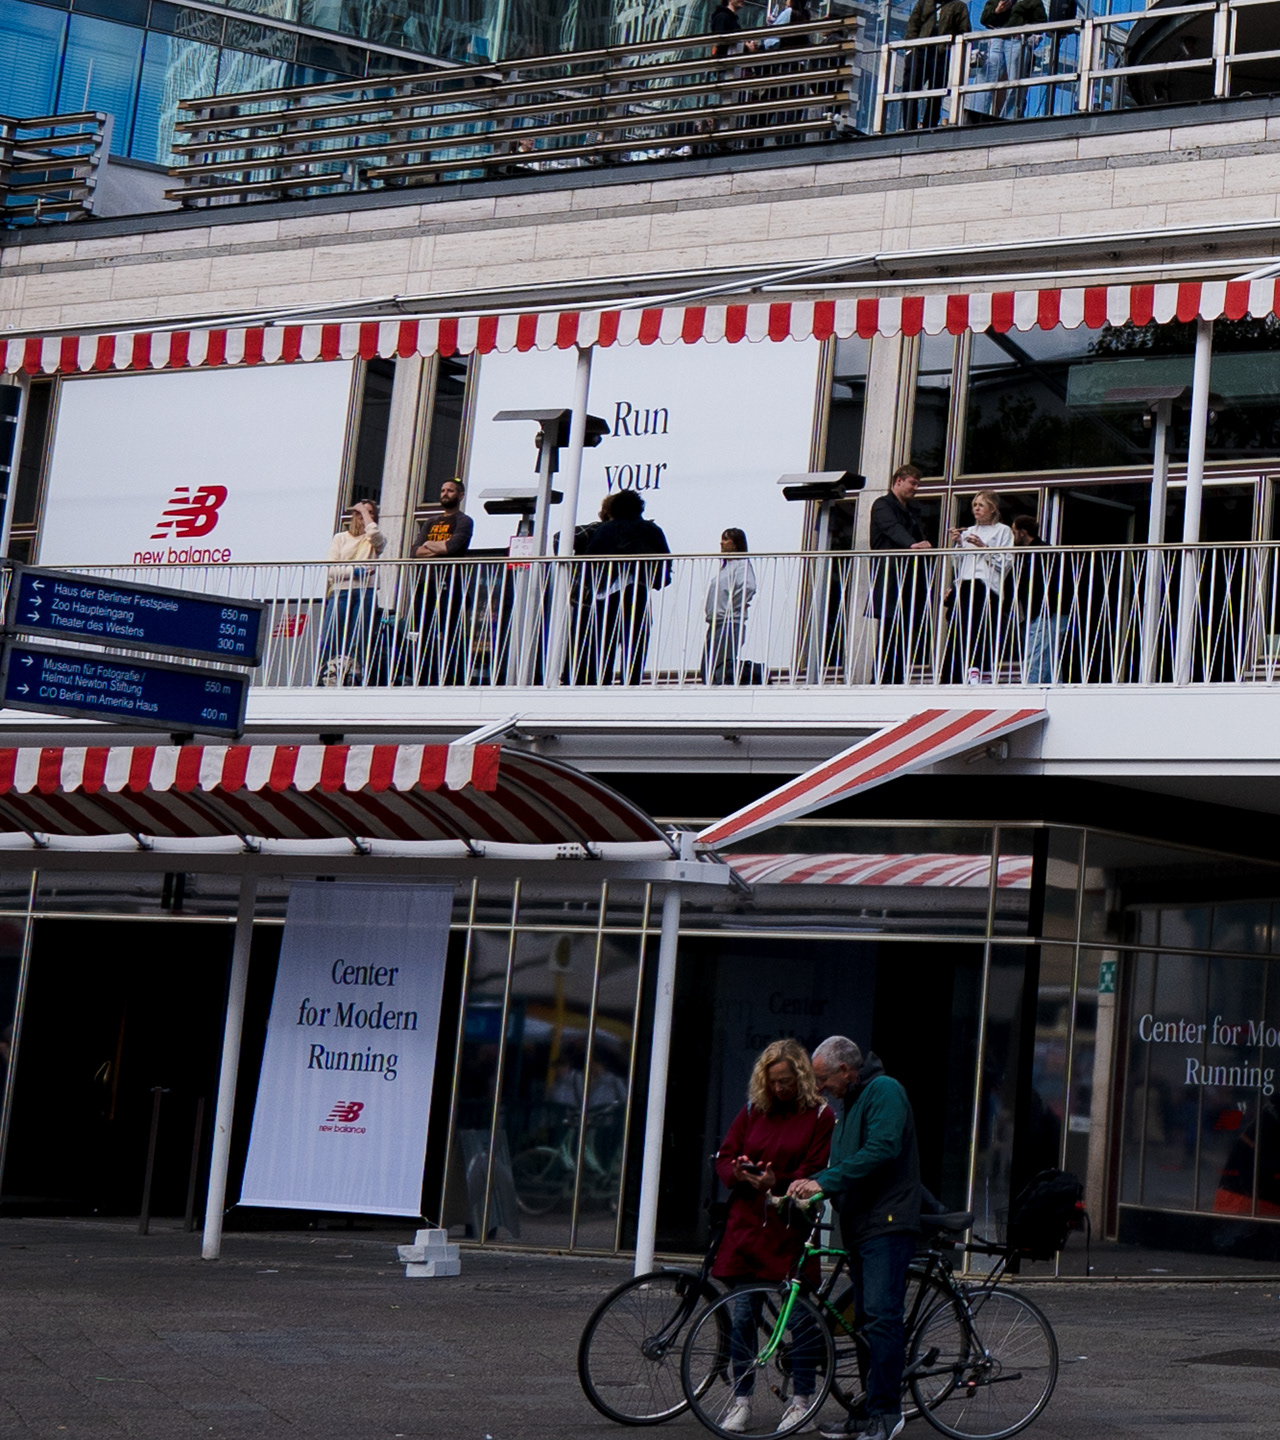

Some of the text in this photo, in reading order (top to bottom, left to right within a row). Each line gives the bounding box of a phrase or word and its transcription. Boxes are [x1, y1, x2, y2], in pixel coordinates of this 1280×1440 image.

[611, 401, 669, 437] Run
[604, 462, 668, 495] your
[133, 546, 232, 564] new balance
[52, 598, 247, 637] Zoo Haupteingang 550 m
[54, 583, 249, 622] Haus der Berliner Festspiele 650 m
[50, 613, 245, 652] Theater des Westens 300 m
[41, 671, 143, 696] Helmut Newton Stiftung
[43, 658, 82, 674] Museum
[83, 663, 96, 675] für
[97, 666, 139, 682] Fotografie
[39, 686, 228, 722] C/O Berlin im Amerika Haus 400 m
[205, 681, 231, 694] 550 m
[332, 958, 398, 987] Center
[296, 997, 419, 1031] for Modern
[1139, 1014, 1207, 1044] Center
[1211, 1014, 1242, 1046] for
[307, 1043, 398, 1082] Running
[1183, 1057, 1275, 1096] Running
[318, 1124, 366, 1134] new balance
